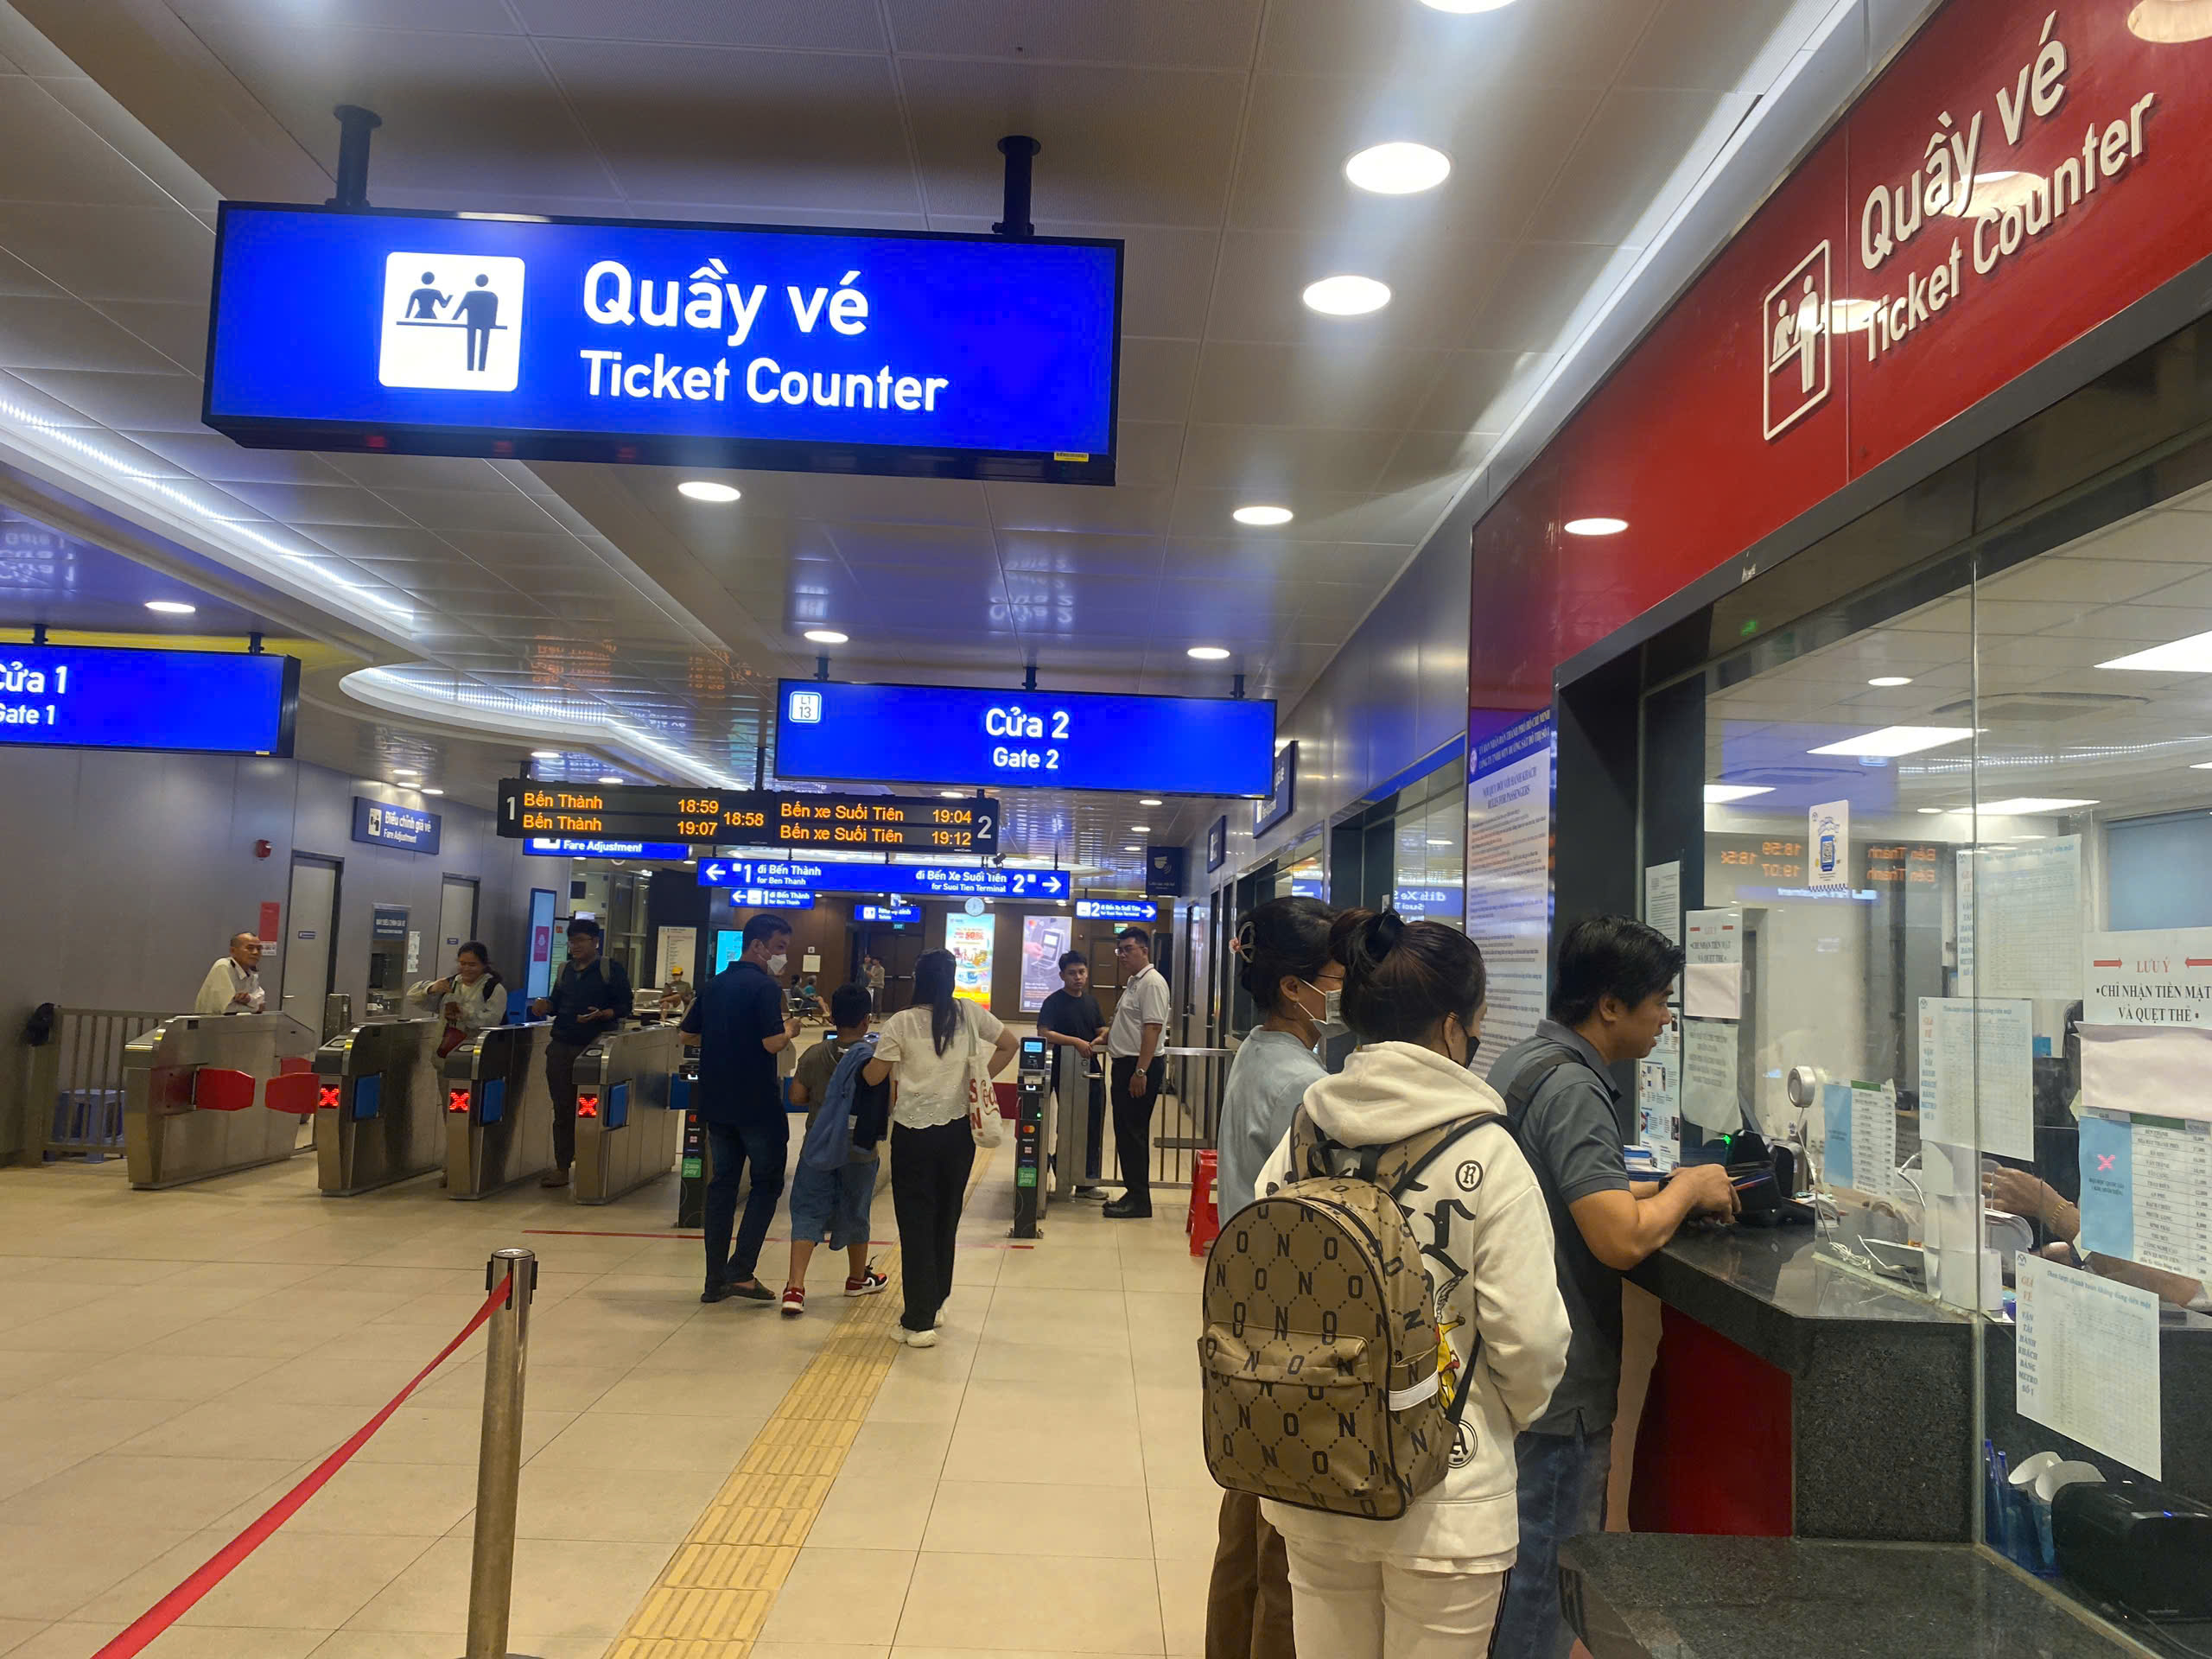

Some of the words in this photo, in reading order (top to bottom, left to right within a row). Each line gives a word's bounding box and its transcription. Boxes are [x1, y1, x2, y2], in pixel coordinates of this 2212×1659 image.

[1861, 111, 1982, 270] Quầy
[1996, 10, 2068, 146] vé
[1867, 236, 1961, 361] Ticket
[1973, 92, 2157, 274] Counter
[584, 258, 766, 346] Quầy
[787, 271, 868, 334] vé
[581, 350, 729, 400] Ticket
[747, 358, 948, 410] Counter
[55, 665, 67, 694] 1
[801, 696, 810, 705] L1
[46, 704, 55, 725] 1
[799, 706, 811, 718] 13
[986, 706, 1043, 738] Cửa
[1052, 710, 1070, 739] 2
[993, 747, 1040, 768] Gate
[1046, 749, 1058, 769] 2
[506, 797, 516, 820] 1
[524, 791, 553, 808] Bến
[558, 794, 603, 810] Thành
[677, 799, 719, 814] 18:59
[781, 801, 810, 818] Bến
[814, 806, 831, 818] xe
[835, 803, 868, 820] Suối
[872, 806, 904, 822] Tiên
[932, 809, 972, 823] 19:04
[523, 812, 553, 830] Bến
[557, 815, 602, 832] Thành
[677, 821, 718, 836] 19:07
[723, 811, 764, 826] 18:58
[977, 815, 992, 839] 2
[780, 823, 810, 840] Bến
[813, 828, 830, 841] xe
[834, 824, 868, 842] Suối
[872, 828, 903, 843] Tiên
[931, 830, 972, 846] 19:12
[563, 840, 585, 851] Fare
[587, 841, 642, 855] Adjustment
[744, 864, 752, 883] 1
[757, 864, 767, 874] đi
[769, 863, 789, 875] Bến
[791, 864, 822, 876] Thành
[916, 871, 925, 880] đi
[927, 869, 947, 880] Bến
[949, 871, 962, 881] Xe
[963, 870, 984, 882] Suối
[785, 877, 806, 886] Thanh
[1013, 874, 1025, 893] 2
[763, 890, 769, 905] 1
[1091, 902, 1100, 917] 2
[2136, 958, 2160, 973] LƯU
[2163, 956, 2171, 973] Ý
[2122, 983, 2152, 1001] NHẬN
[2119, 1003, 2133, 1020] VÀ
[2136, 1007, 2166, 1023] QUẸT
[1277, 1234, 1290, 1257] N
[1216, 1264, 1225, 1287] N
[1299, 1272, 1313, 1295] N
[1243, 1351, 1260, 1371] N
[1238, 1404, 1250, 1429] N
[1338, 1412, 1356, 1437] N
[1261, 1445, 1279, 1467] N
